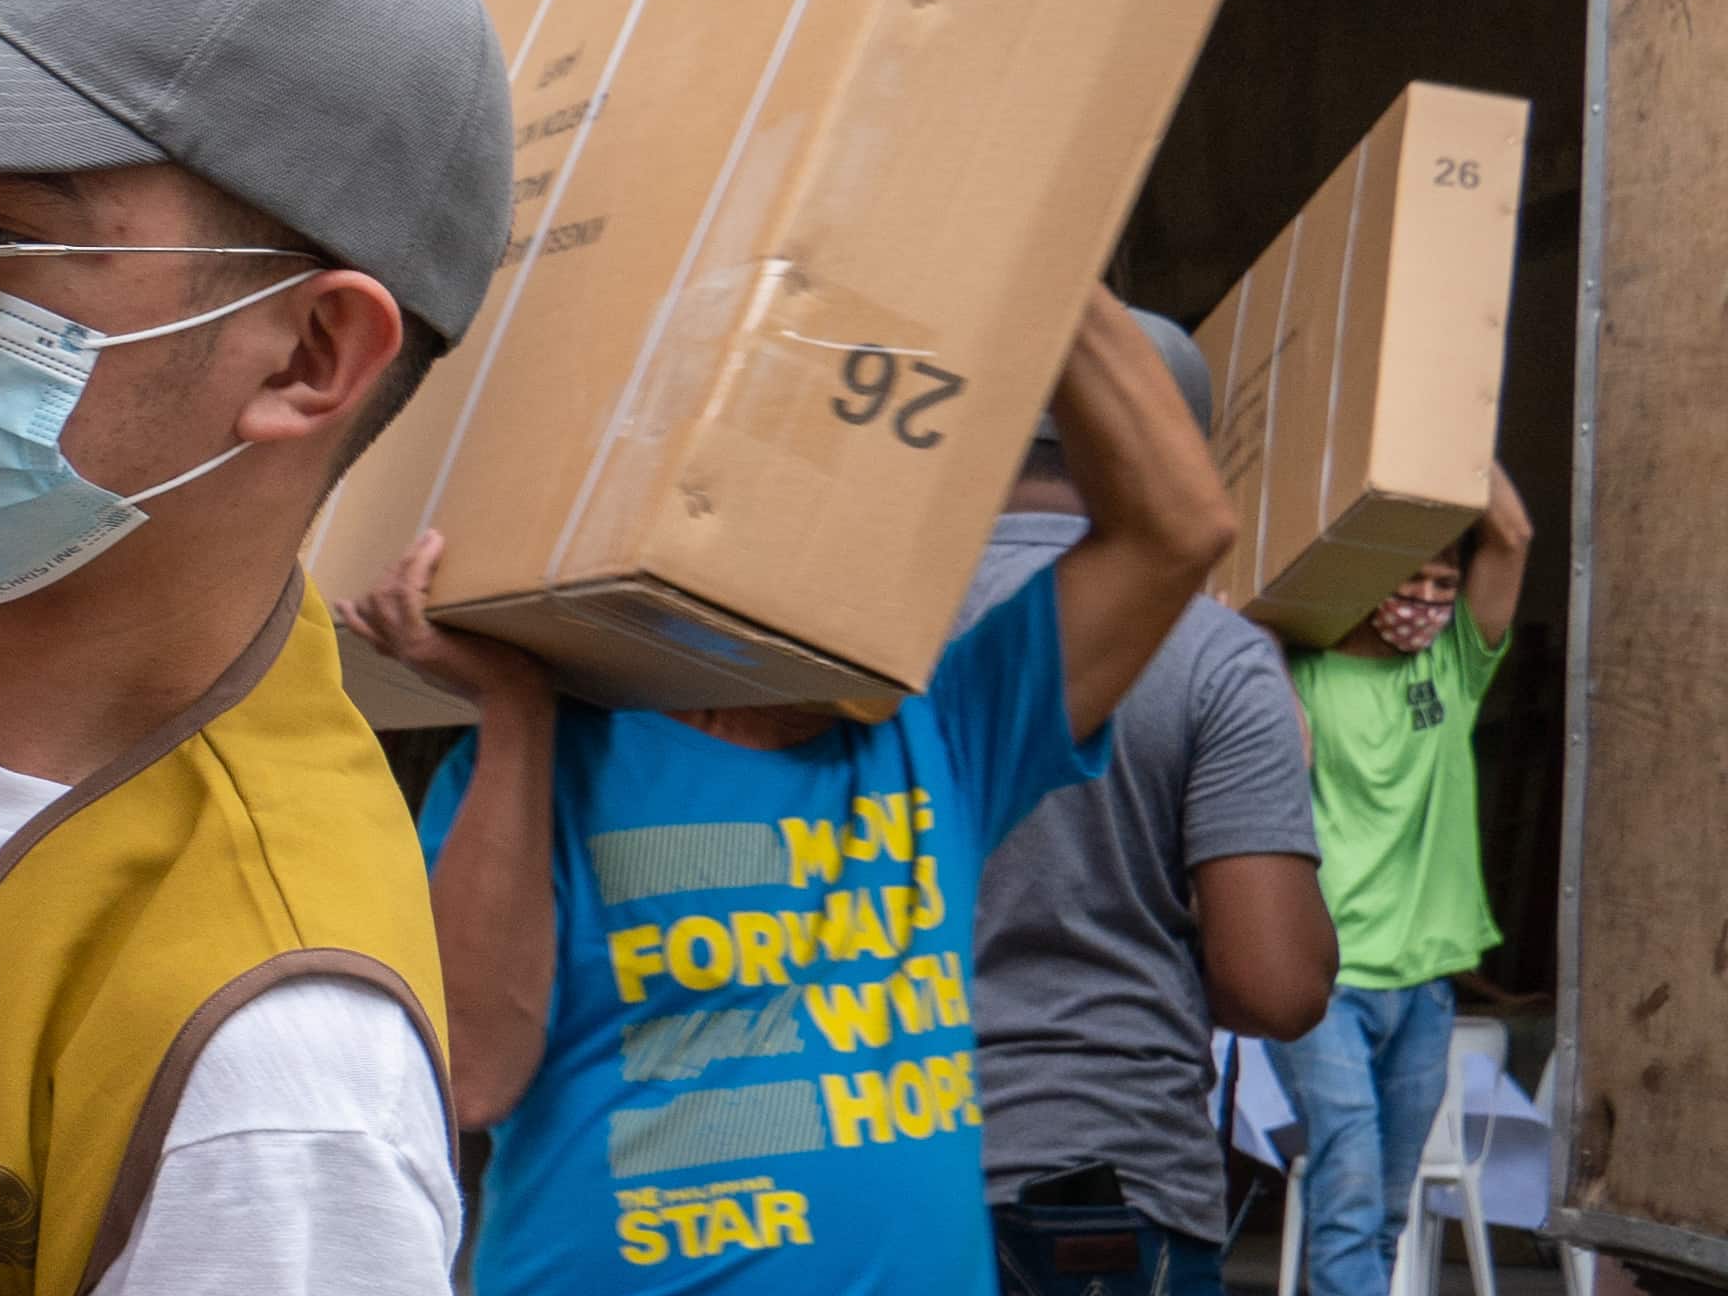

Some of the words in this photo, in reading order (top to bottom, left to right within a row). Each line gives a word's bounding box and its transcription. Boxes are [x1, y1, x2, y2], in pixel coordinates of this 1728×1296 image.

[1432, 158, 1481, 190] 26
[831, 344, 967, 449] 26
[617, 1191, 813, 1265] STAR
